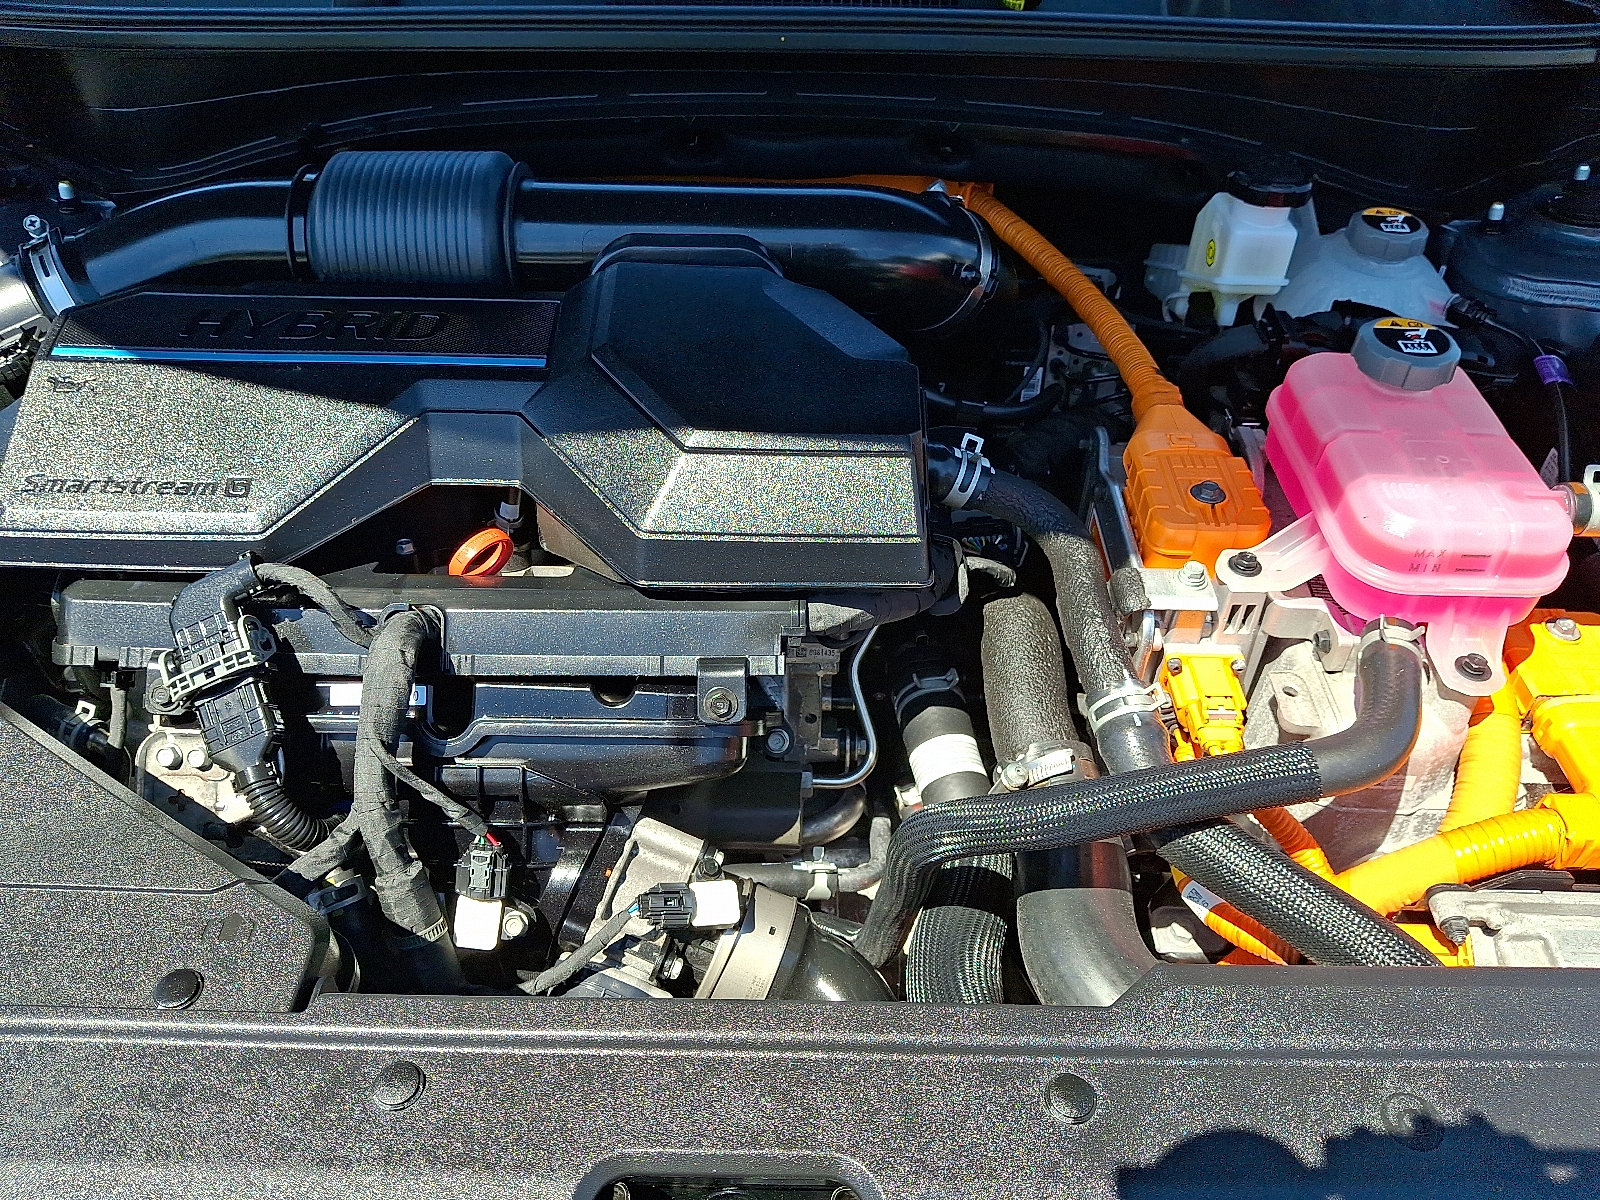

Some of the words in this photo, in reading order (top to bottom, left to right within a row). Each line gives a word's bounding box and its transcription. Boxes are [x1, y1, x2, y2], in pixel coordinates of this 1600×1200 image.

[179, 308, 449, 341] HYBRID
[21, 474, 217, 496] Smartstream
[1413, 549, 1447, 559] MAX
[1408, 563, 1441, 573] MIN
